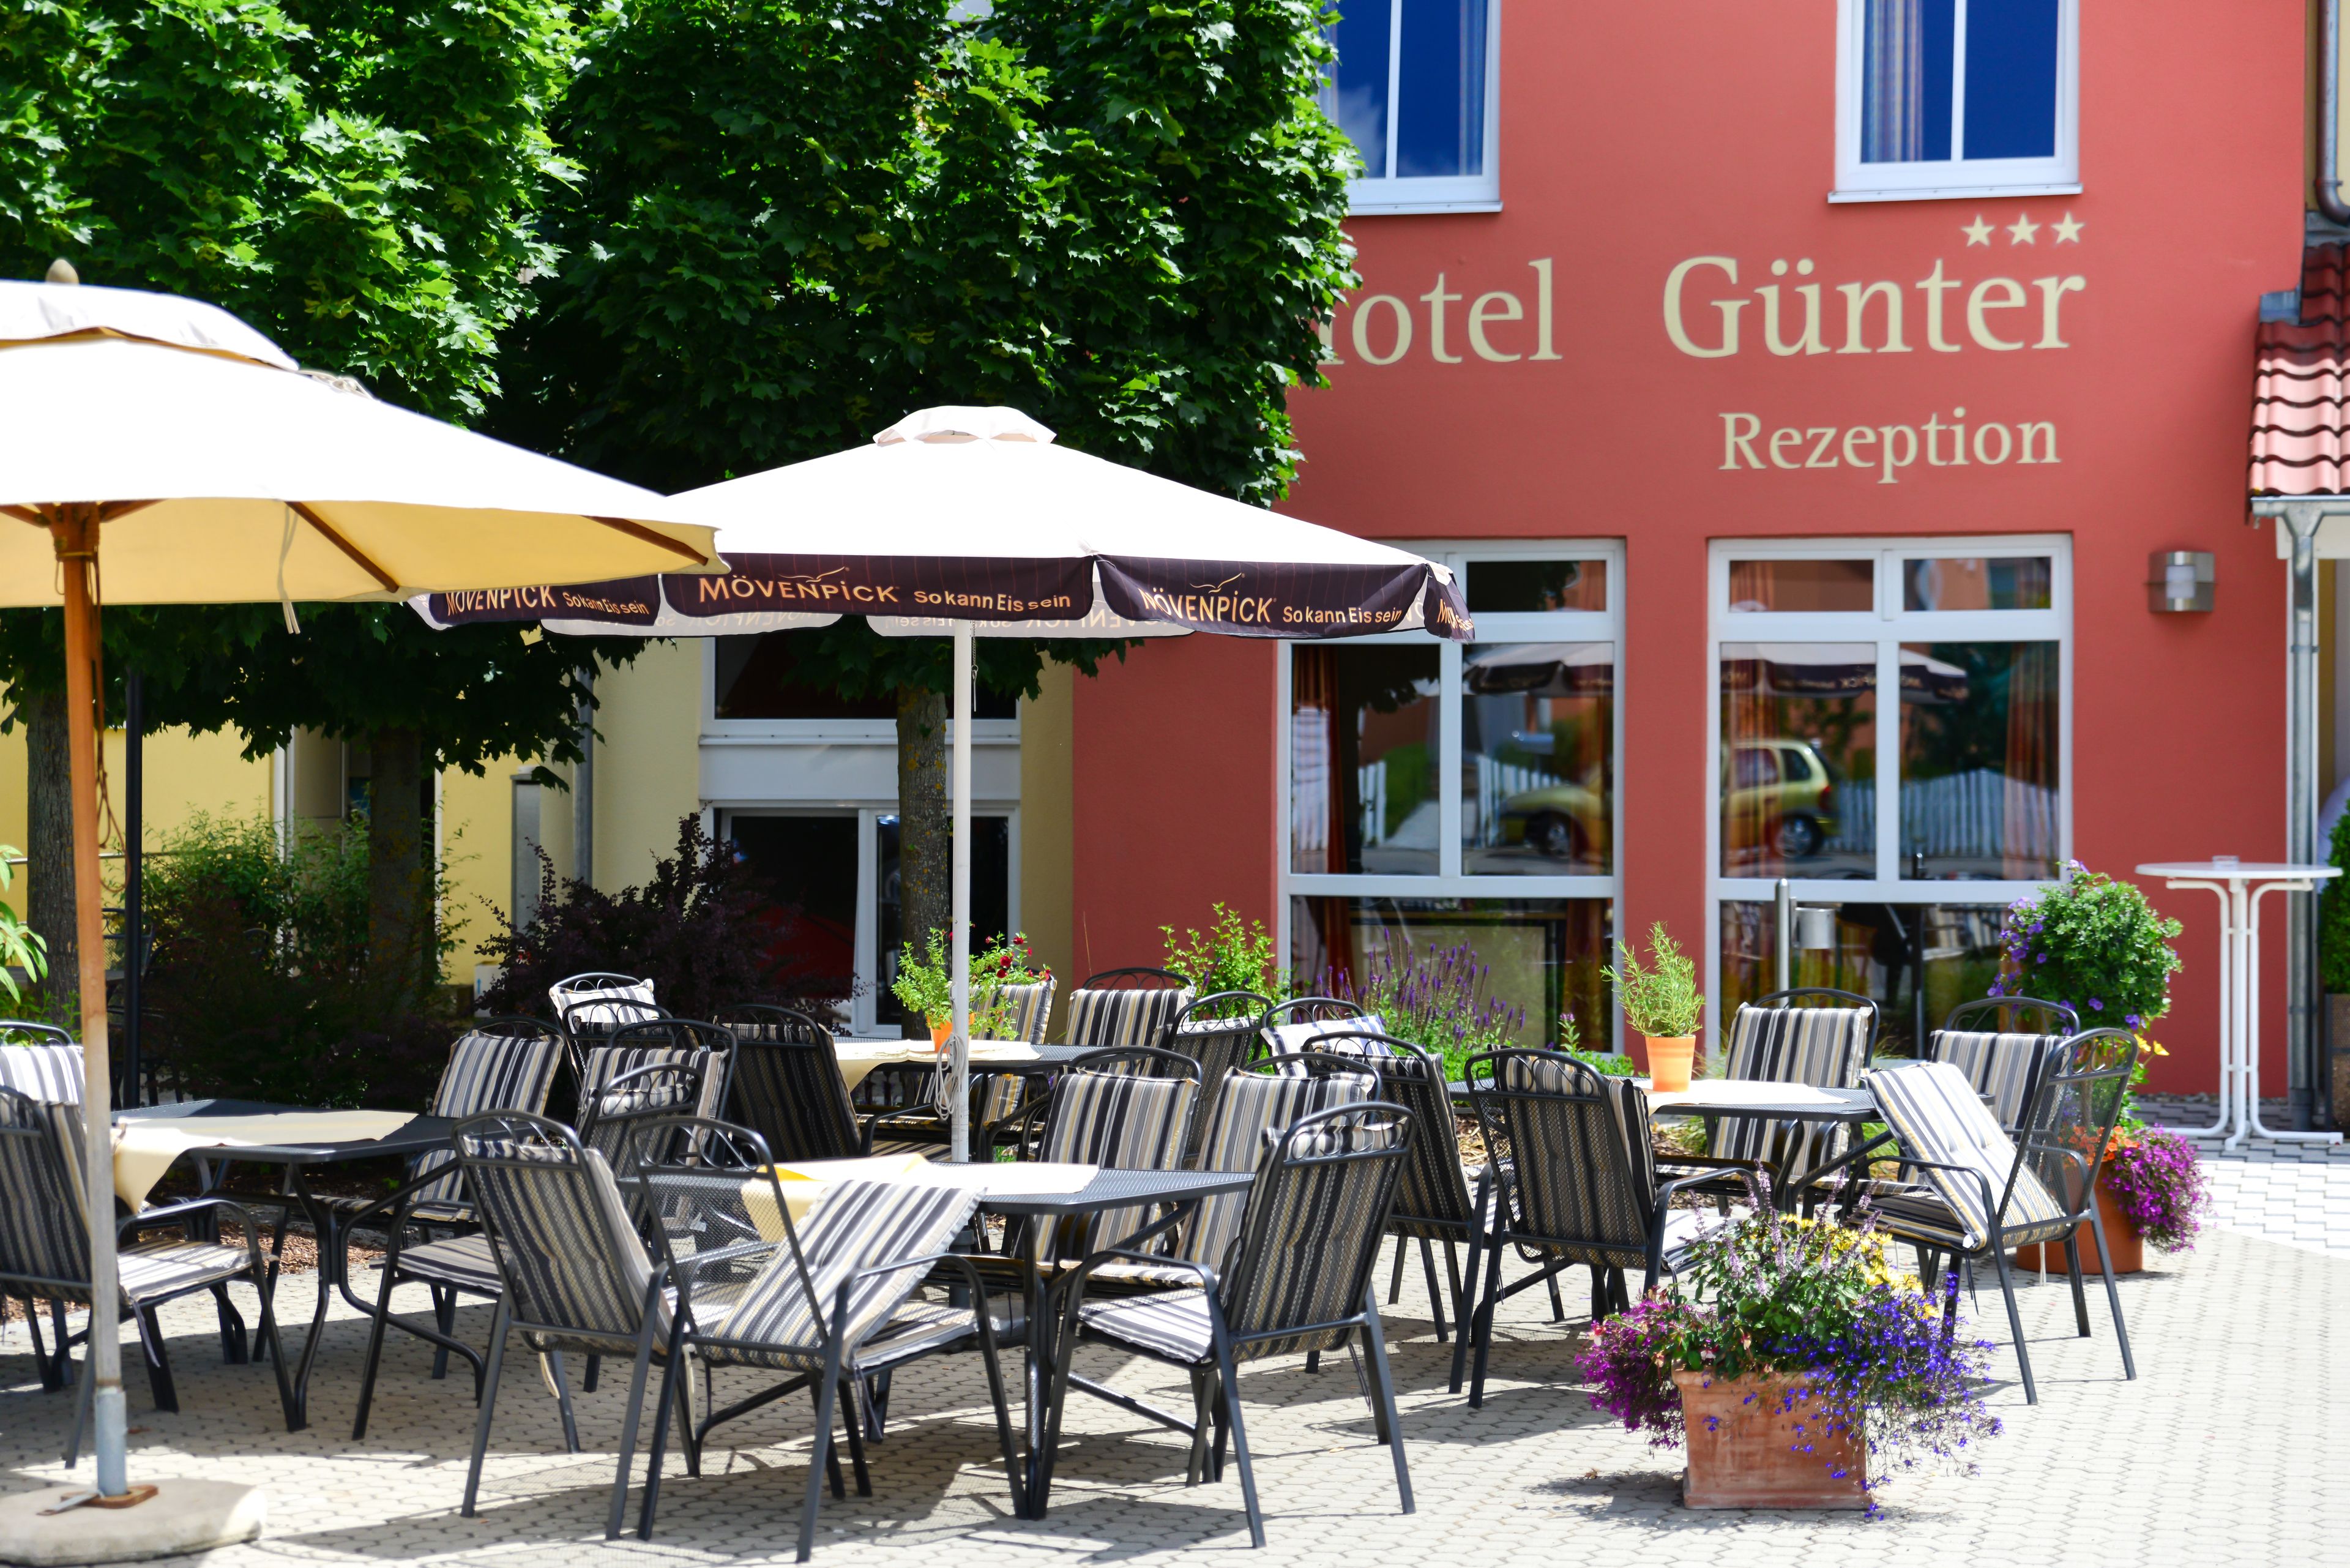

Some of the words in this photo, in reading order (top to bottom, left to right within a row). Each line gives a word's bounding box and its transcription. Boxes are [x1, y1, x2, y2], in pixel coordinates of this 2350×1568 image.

[1662, 255, 2086, 359] Günter
[1718, 406, 2062, 484] Rezeption
[1028, 595, 1071, 610] sein
